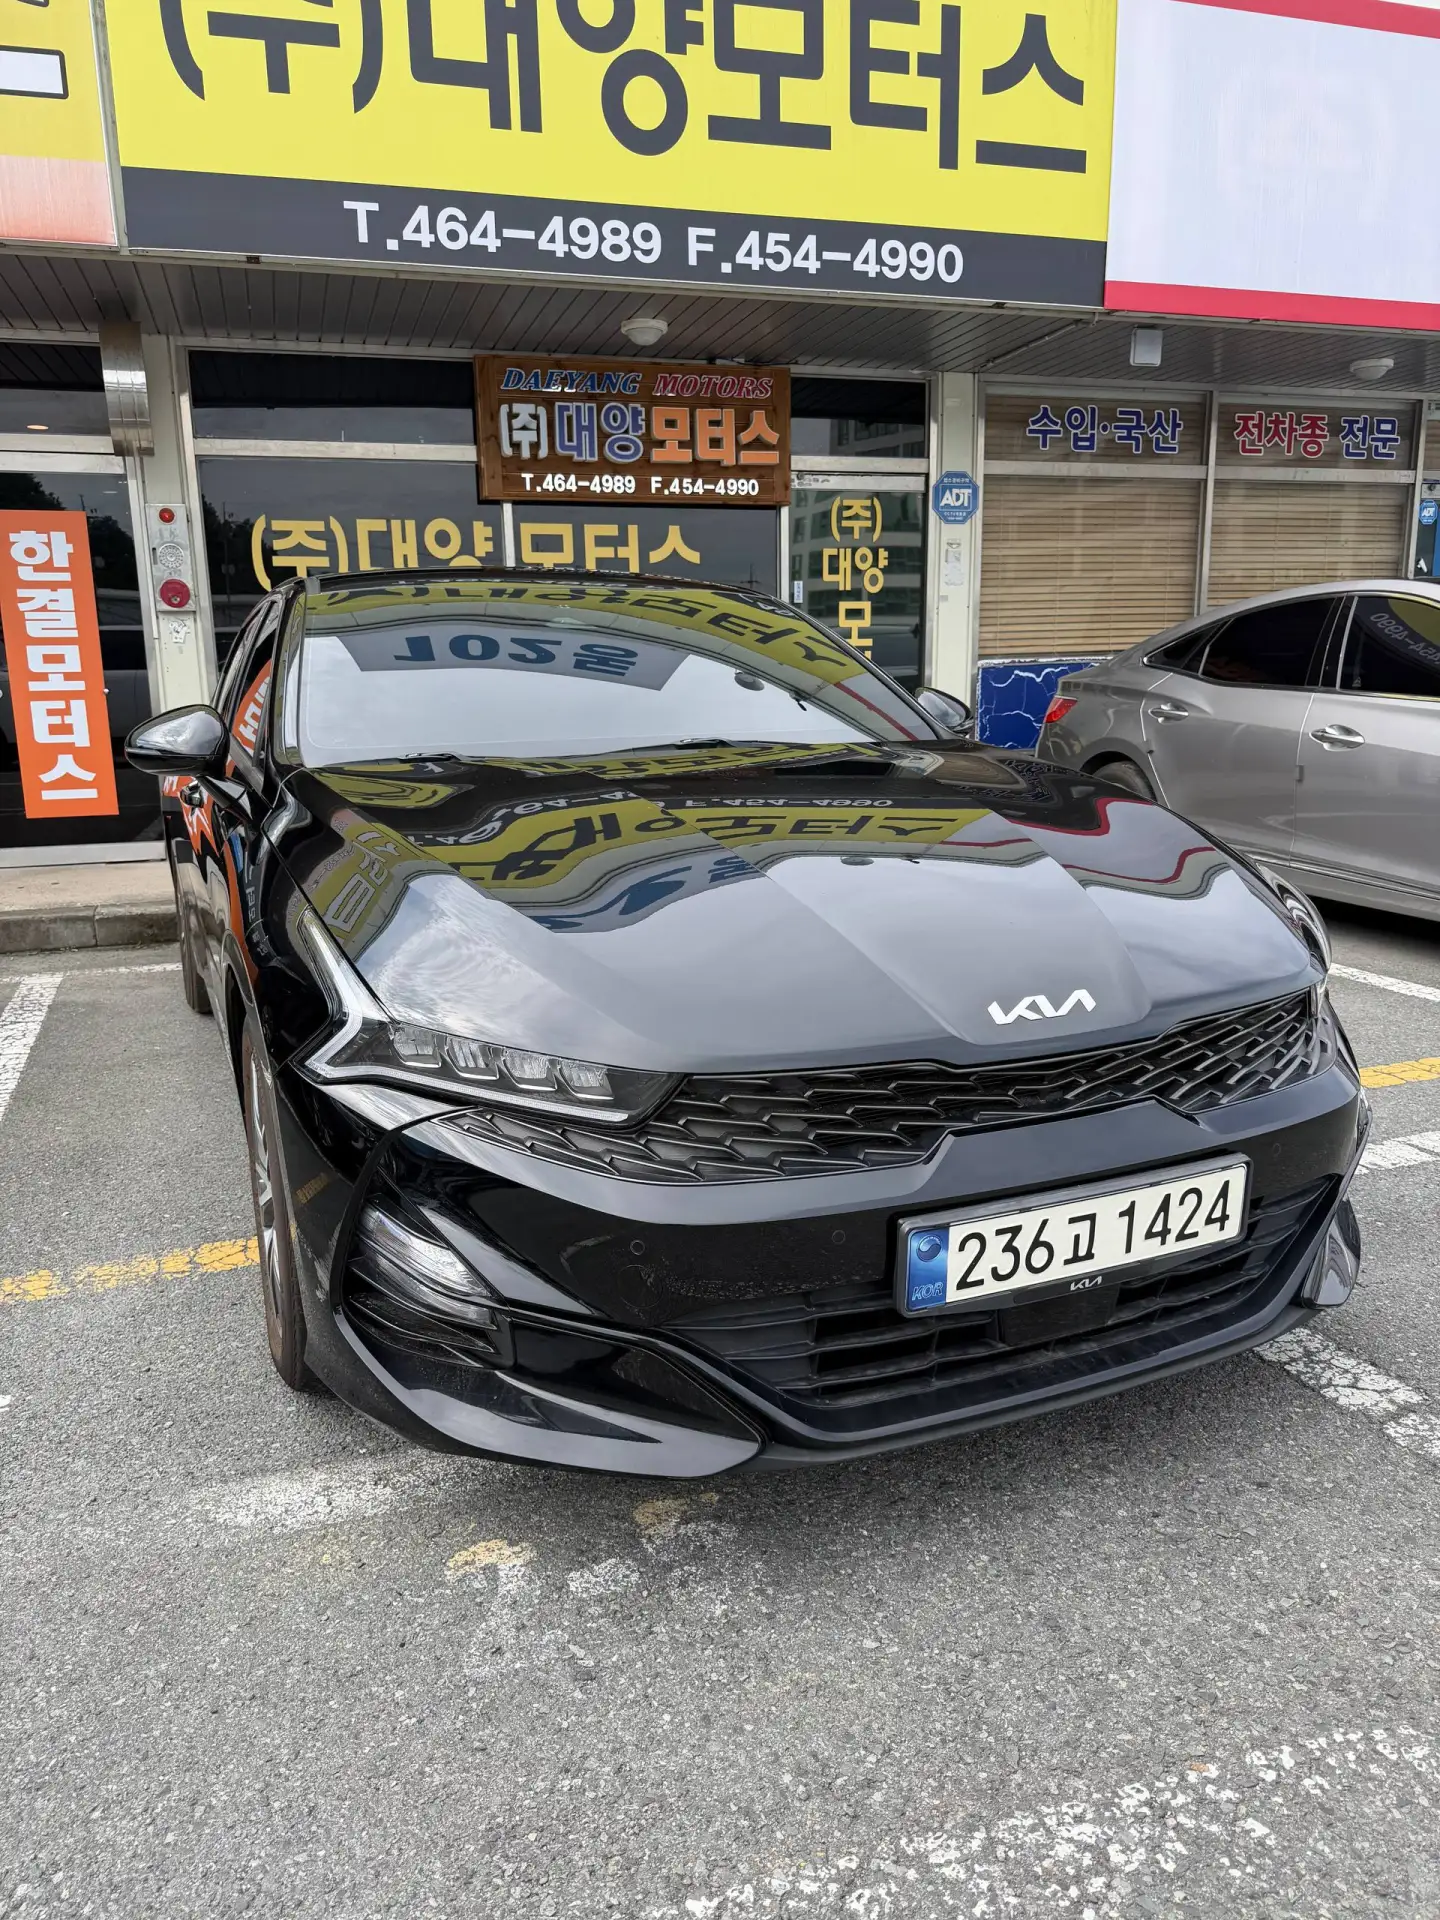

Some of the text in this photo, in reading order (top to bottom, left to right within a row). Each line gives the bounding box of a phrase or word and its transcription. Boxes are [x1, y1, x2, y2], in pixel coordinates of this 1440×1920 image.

[343, 200, 964, 284] T.464-4989 F.454-4990
[501, 367, 773, 399] DAEYANG MOTORS
[1233, 411, 1330, 459] 전차종
[1340, 415, 1401, 460] 전문
[521, 473, 760, 496] T.464-4989 F.454-4990
[939, 488, 972, 507] ADT
[822, 546, 889, 594] 대양
[8, 530, 99, 801] 한결모터스
[987, 988, 1097, 1026] KIA
[955, 1179, 1230, 1291] 236고 1424
[911, 1281, 944, 1301] KOR
[1069, 1275, 1102, 1292] KIA
